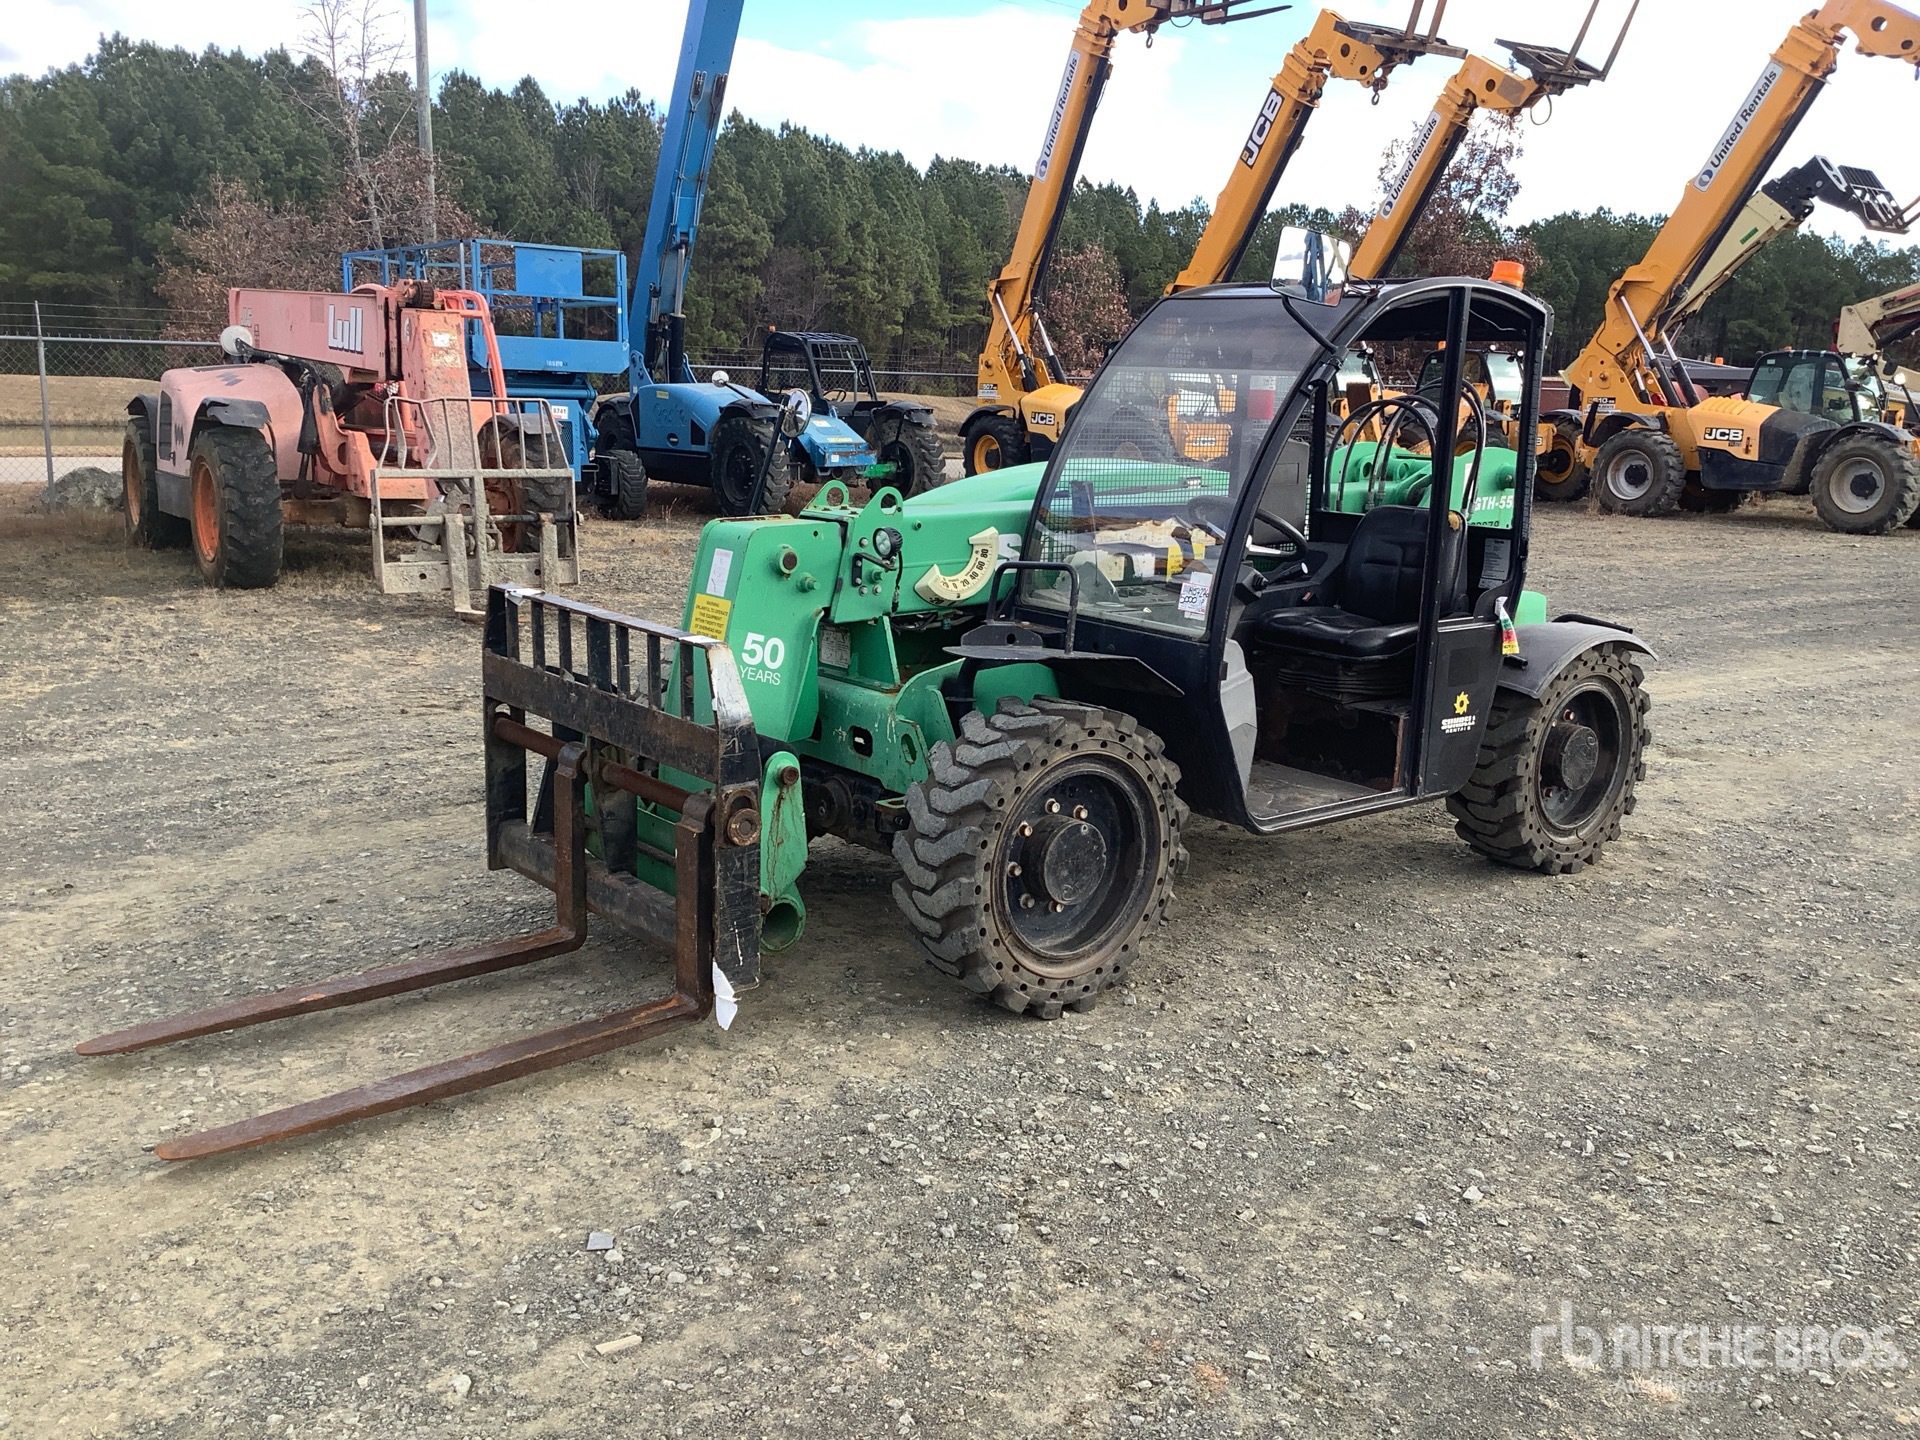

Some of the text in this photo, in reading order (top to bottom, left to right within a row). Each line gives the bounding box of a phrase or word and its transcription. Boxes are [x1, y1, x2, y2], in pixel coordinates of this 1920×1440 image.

[1044, 57, 1078, 157] United Rentals
[1710, 70, 1777, 168] United Rentals
[1246, 91, 1283, 166] JCB
[1391, 118, 1437, 200] United Rentals
[1031, 412, 1055, 425] JCB
[1704, 428, 1743, 441] JCB
[976, 561, 986, 570] 60
[980, 548, 989, 558] 80
[742, 632, 785, 670] 50
[740, 665, 781, 686] YEARS
